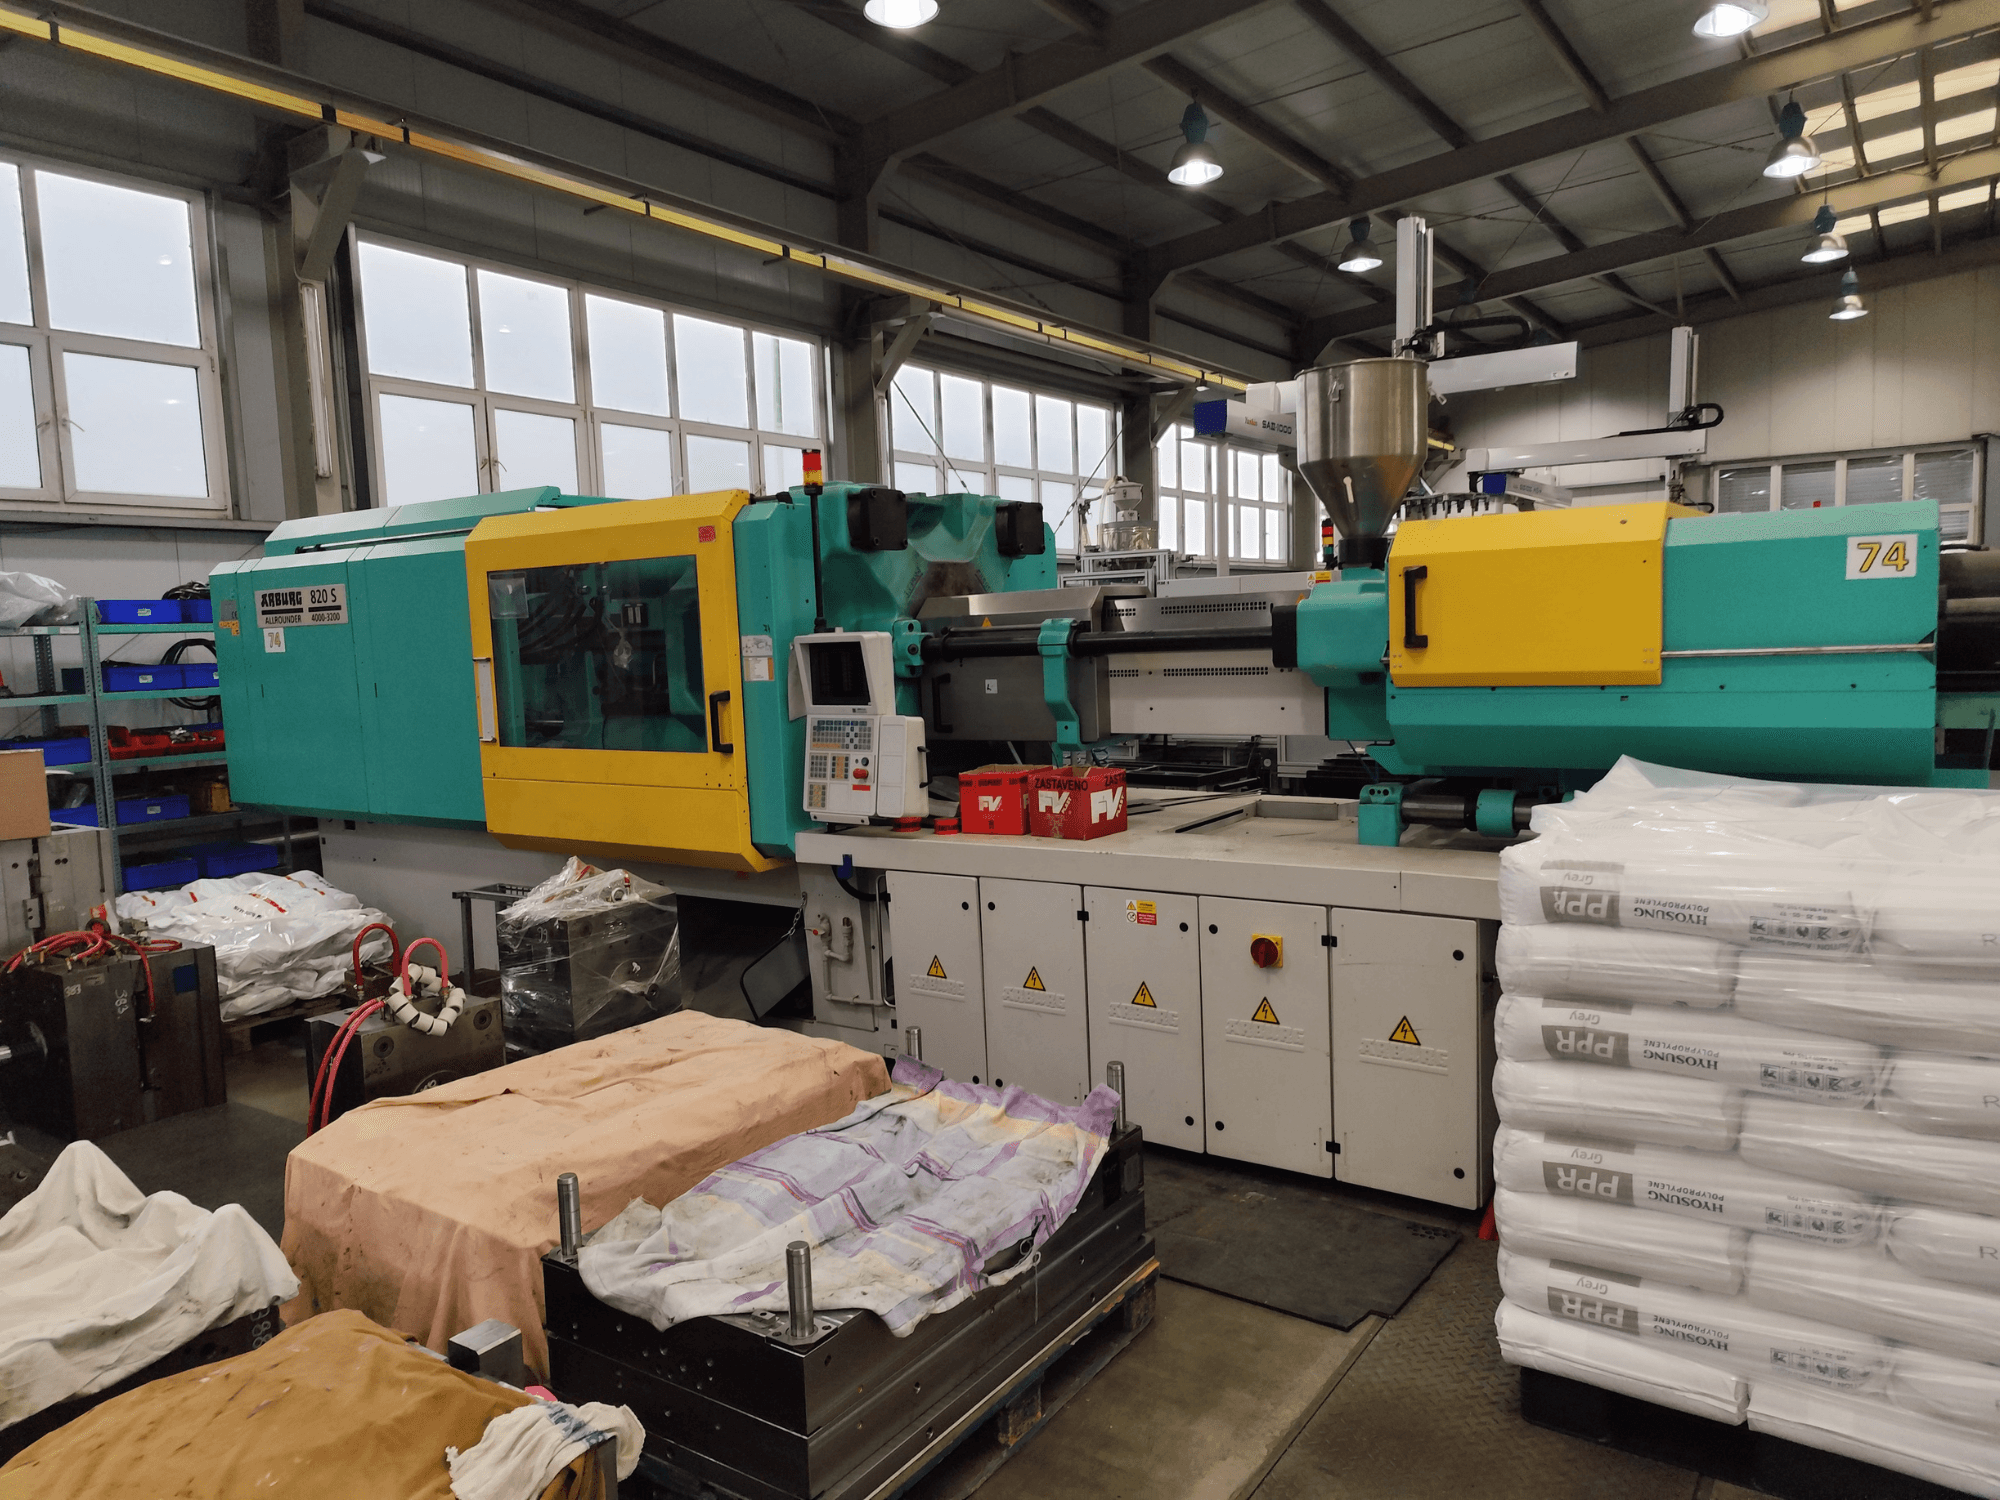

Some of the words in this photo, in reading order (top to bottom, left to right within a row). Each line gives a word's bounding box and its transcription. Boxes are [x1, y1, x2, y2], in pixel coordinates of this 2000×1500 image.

[1857, 541, 1910, 573] 74
[261, 591, 302, 607] ARBURG
[310, 589, 327, 604] 820
[331, 588, 337, 602] S
[265, 615, 302, 625] ALLROUNDER
[311, 613, 341, 622] 4000-3200
[268, 632, 281, 648] 74
[1034, 778, 1089, 791] ZASTAVENO
[978, 796, 1003, 811] FV
[1038, 790, 1070, 814] FV
[1090, 786, 1123, 824] FV
[1563, 872, 1594, 885] Grey
[1634, 897, 1710, 913] POLYPROPYLENE
[1634, 907, 1708, 926] HYOSUNG
[1569, 1010, 1600, 1025] Grey
[1555, 1030, 1616, 1059] PPR
[1643, 1039, 1720, 1058] POLYPROPYLENE
[1643, 1049, 1718, 1070] HYOSUNG
[1570, 1148, 1603, 1164] Grey
[1557, 1167, 1620, 1198] PPR
[1648, 1181, 1724, 1201] POLYPROPYLENE
[1648, 1190, 1723, 1213] HYOSUNG
[1576, 1277, 1608, 1295] Grey
[1561, 1294, 1625, 1329] PPR
[1653, 1315, 1729, 1340] POLYPROPYLENE
[1653, 1324, 1729, 1351] HYOSUNG
